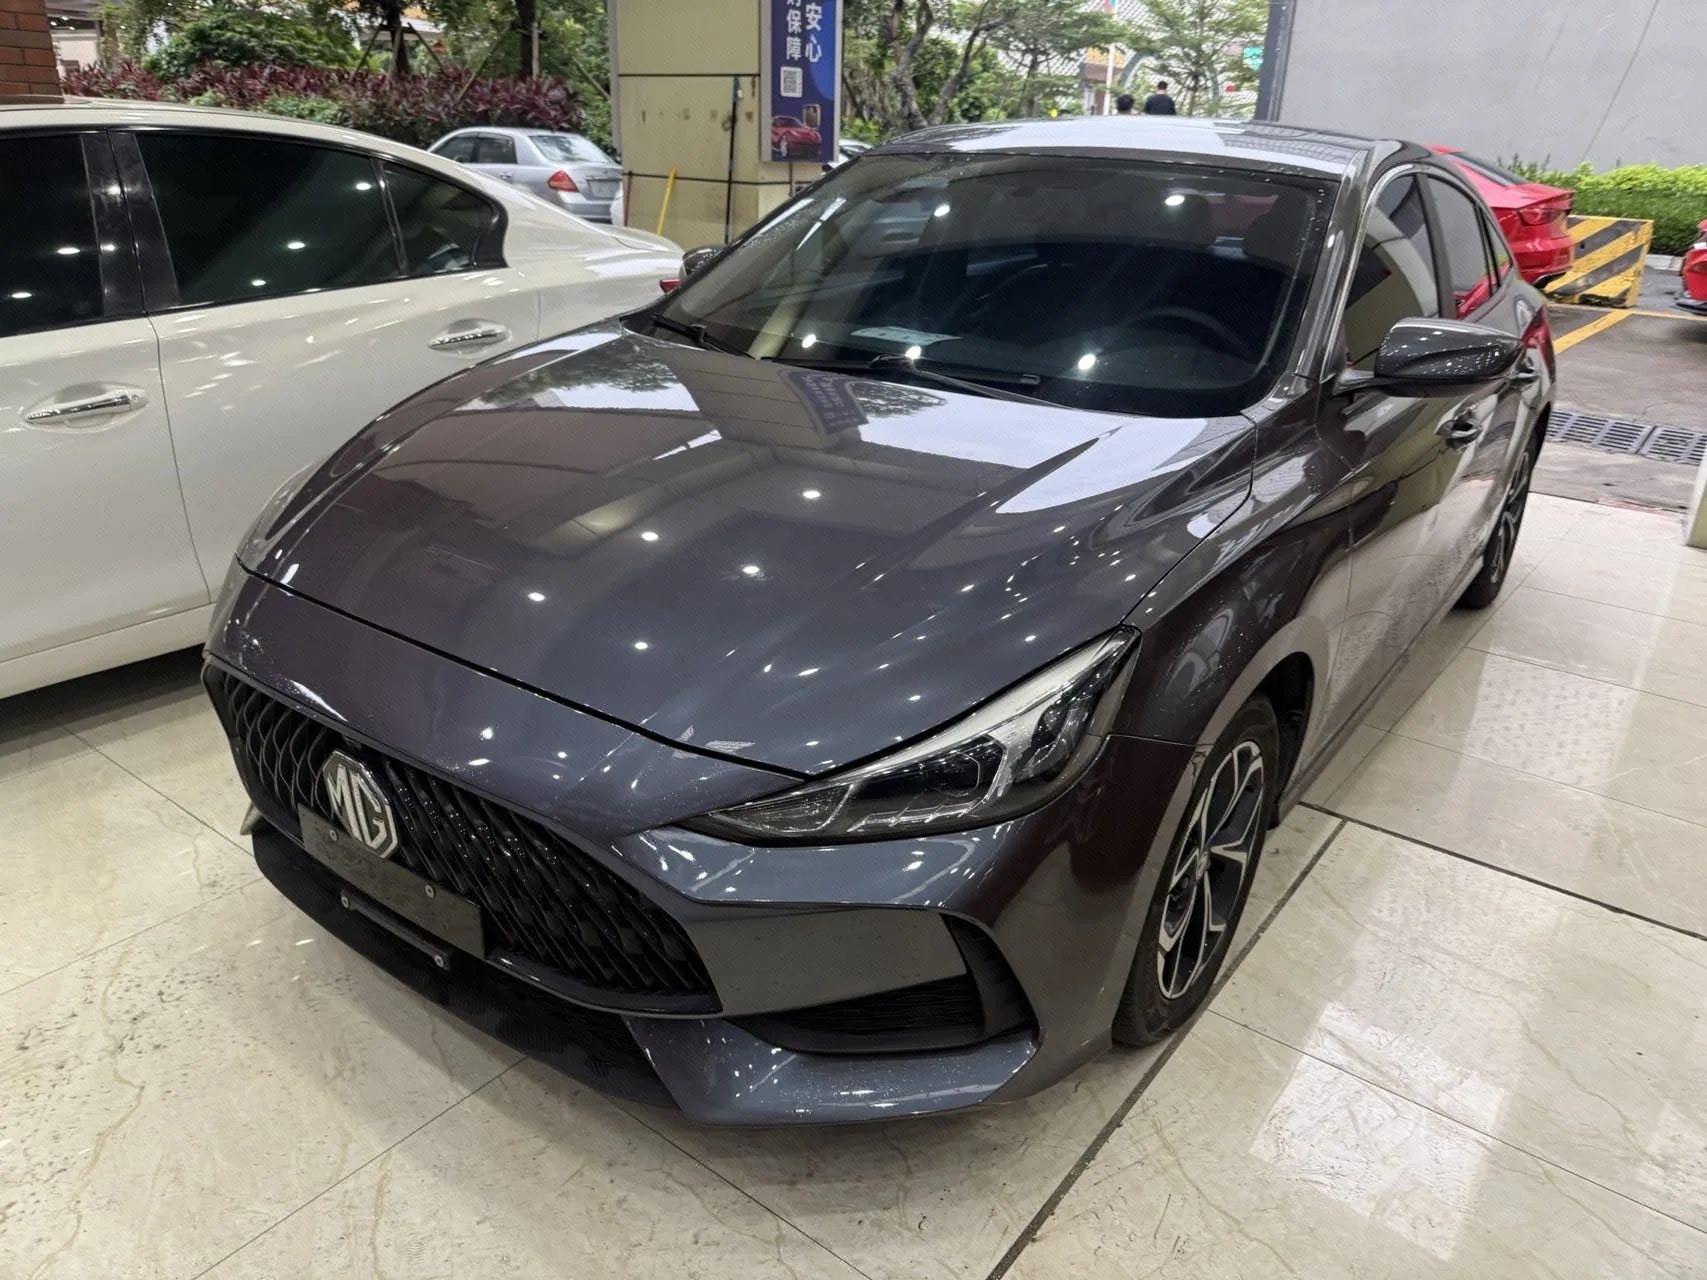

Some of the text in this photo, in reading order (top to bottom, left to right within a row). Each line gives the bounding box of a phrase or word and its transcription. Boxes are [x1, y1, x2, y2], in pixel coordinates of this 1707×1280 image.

[786, 0, 802, 60] 保障
[805, 2, 822, 62] 安心
[326, 762, 388, 849] MG
